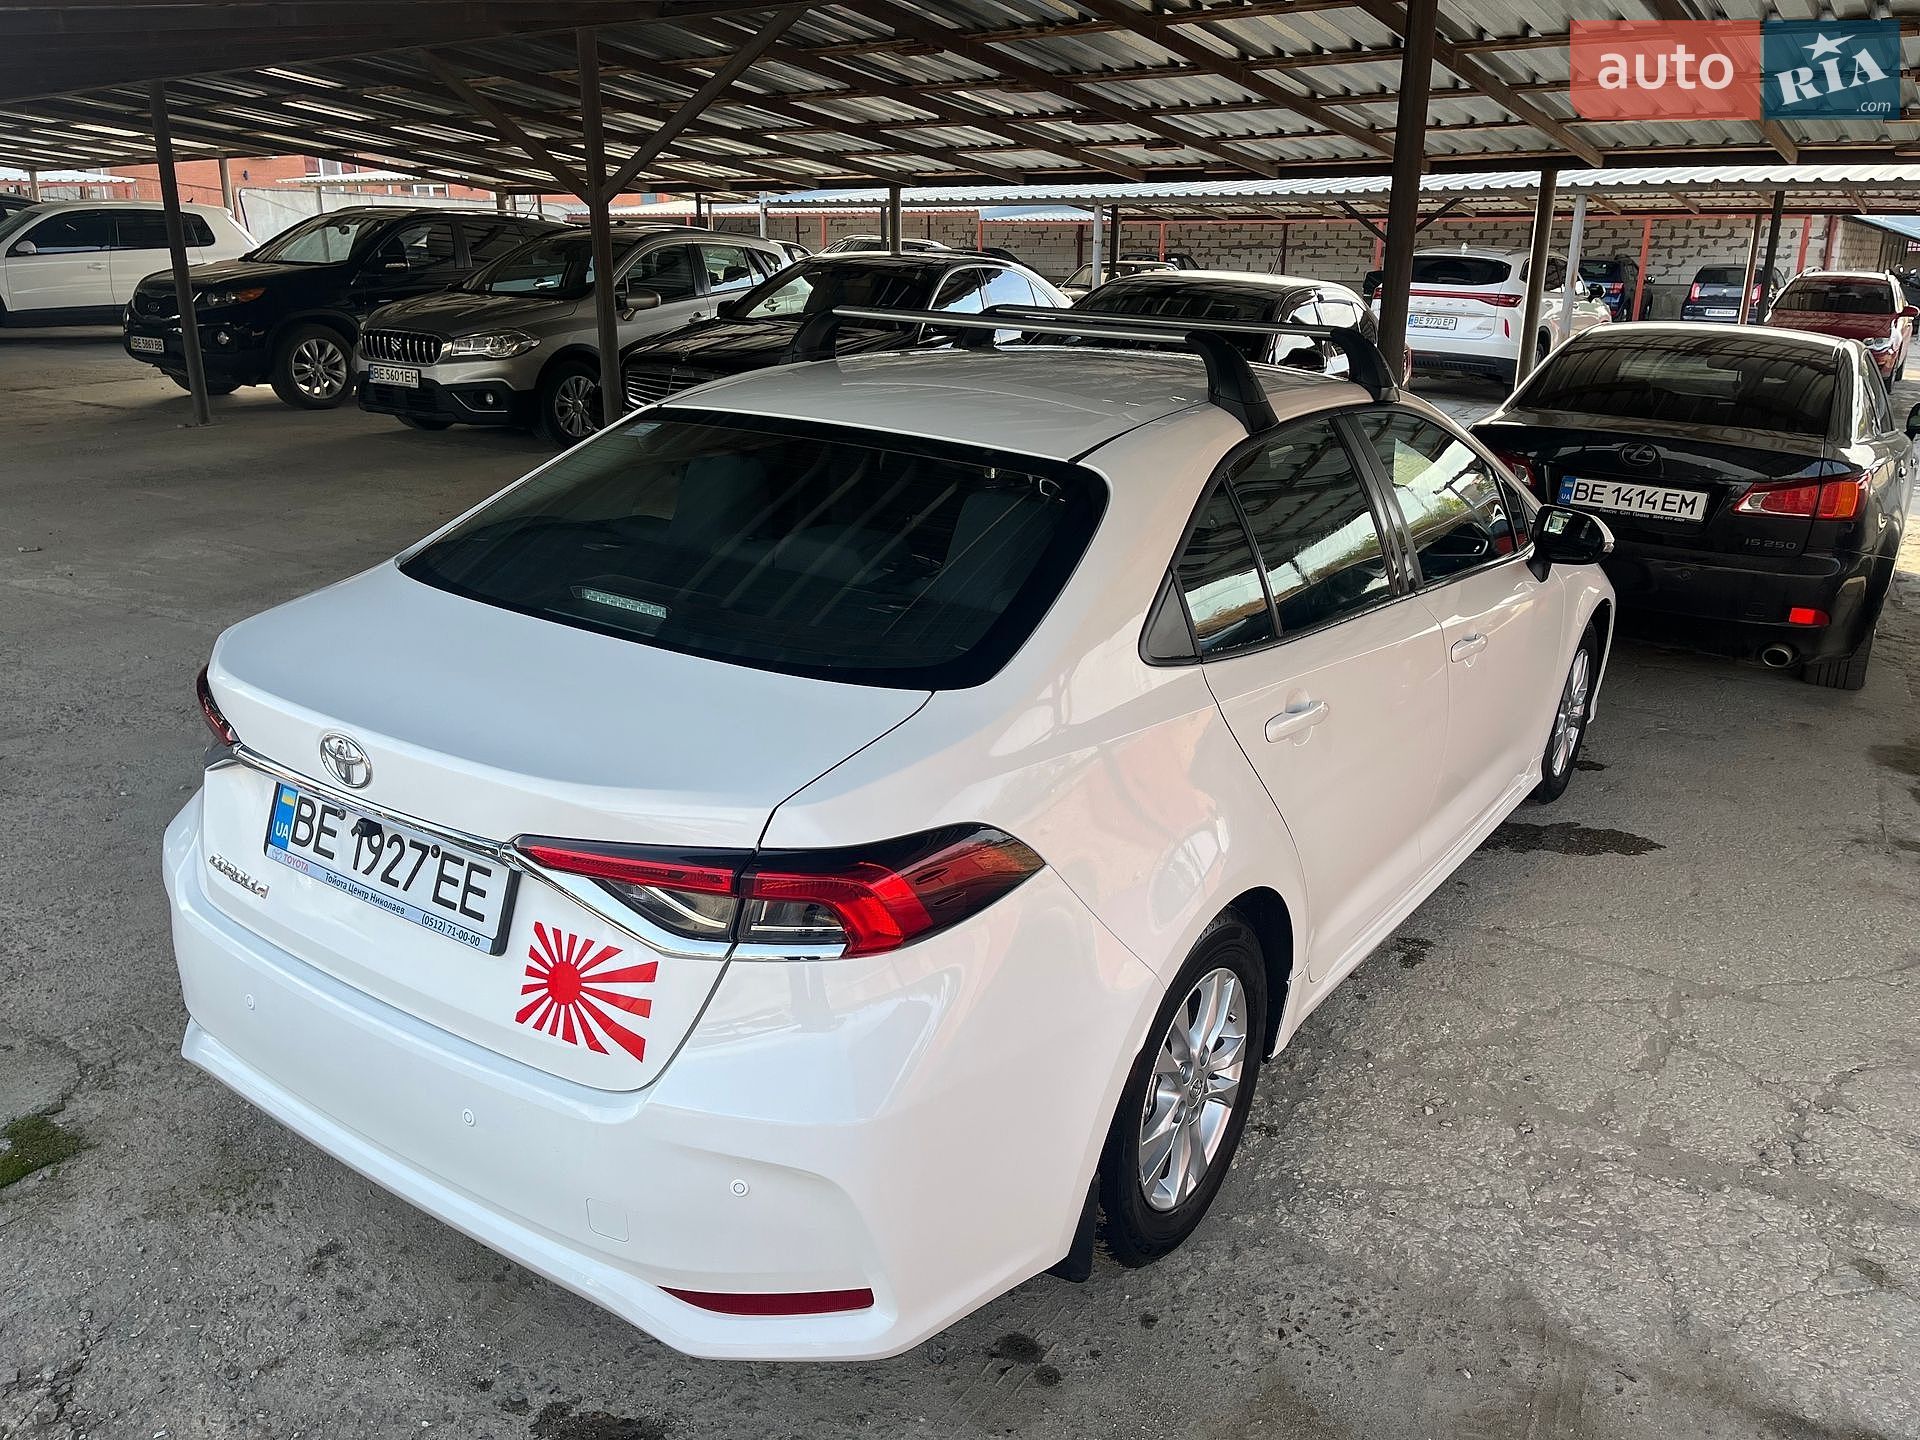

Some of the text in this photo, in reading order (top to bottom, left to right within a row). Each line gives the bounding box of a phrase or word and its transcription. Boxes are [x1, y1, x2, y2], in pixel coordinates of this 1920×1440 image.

[1573, 482, 1698, 515] BE 1414 EM
[1764, 540, 1797, 550] 250
[275, 825, 289, 839] UA
[284, 854, 309, 873] TOYOTA
[291, 796, 492, 922] BE 1927 EE
[325, 872, 405, 914] Тойота Центр Николаев
[422, 913, 481, 946] (0512) 71-00-00
